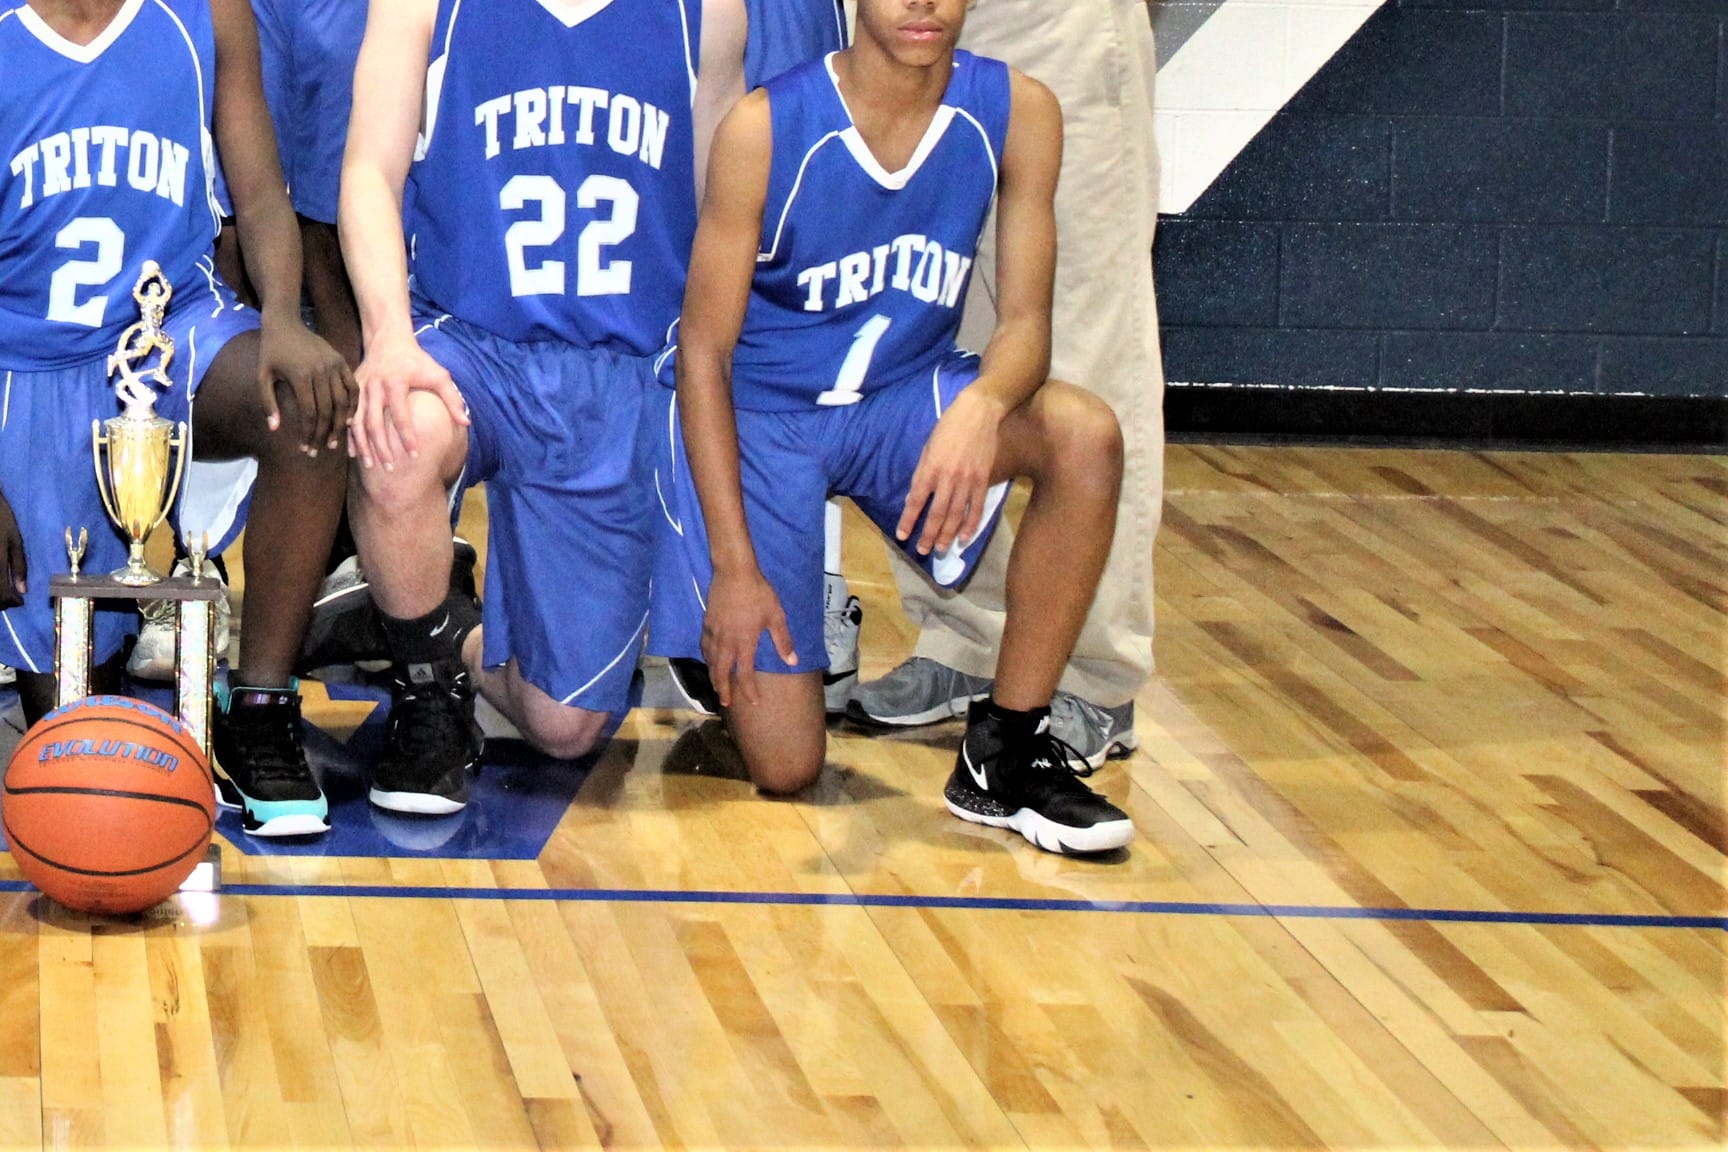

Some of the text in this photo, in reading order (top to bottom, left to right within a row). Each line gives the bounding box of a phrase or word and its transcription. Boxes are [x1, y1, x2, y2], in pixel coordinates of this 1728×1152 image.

[11, 126, 189, 208] TRITON
[475, 86, 669, 169] TRITON
[46, 218, 124, 327] 2
[500, 175, 639, 296] 22
[797, 234, 971, 312] TRITON
[815, 313, 892, 406] 1
[38, 739, 179, 773] EVOLUTION
